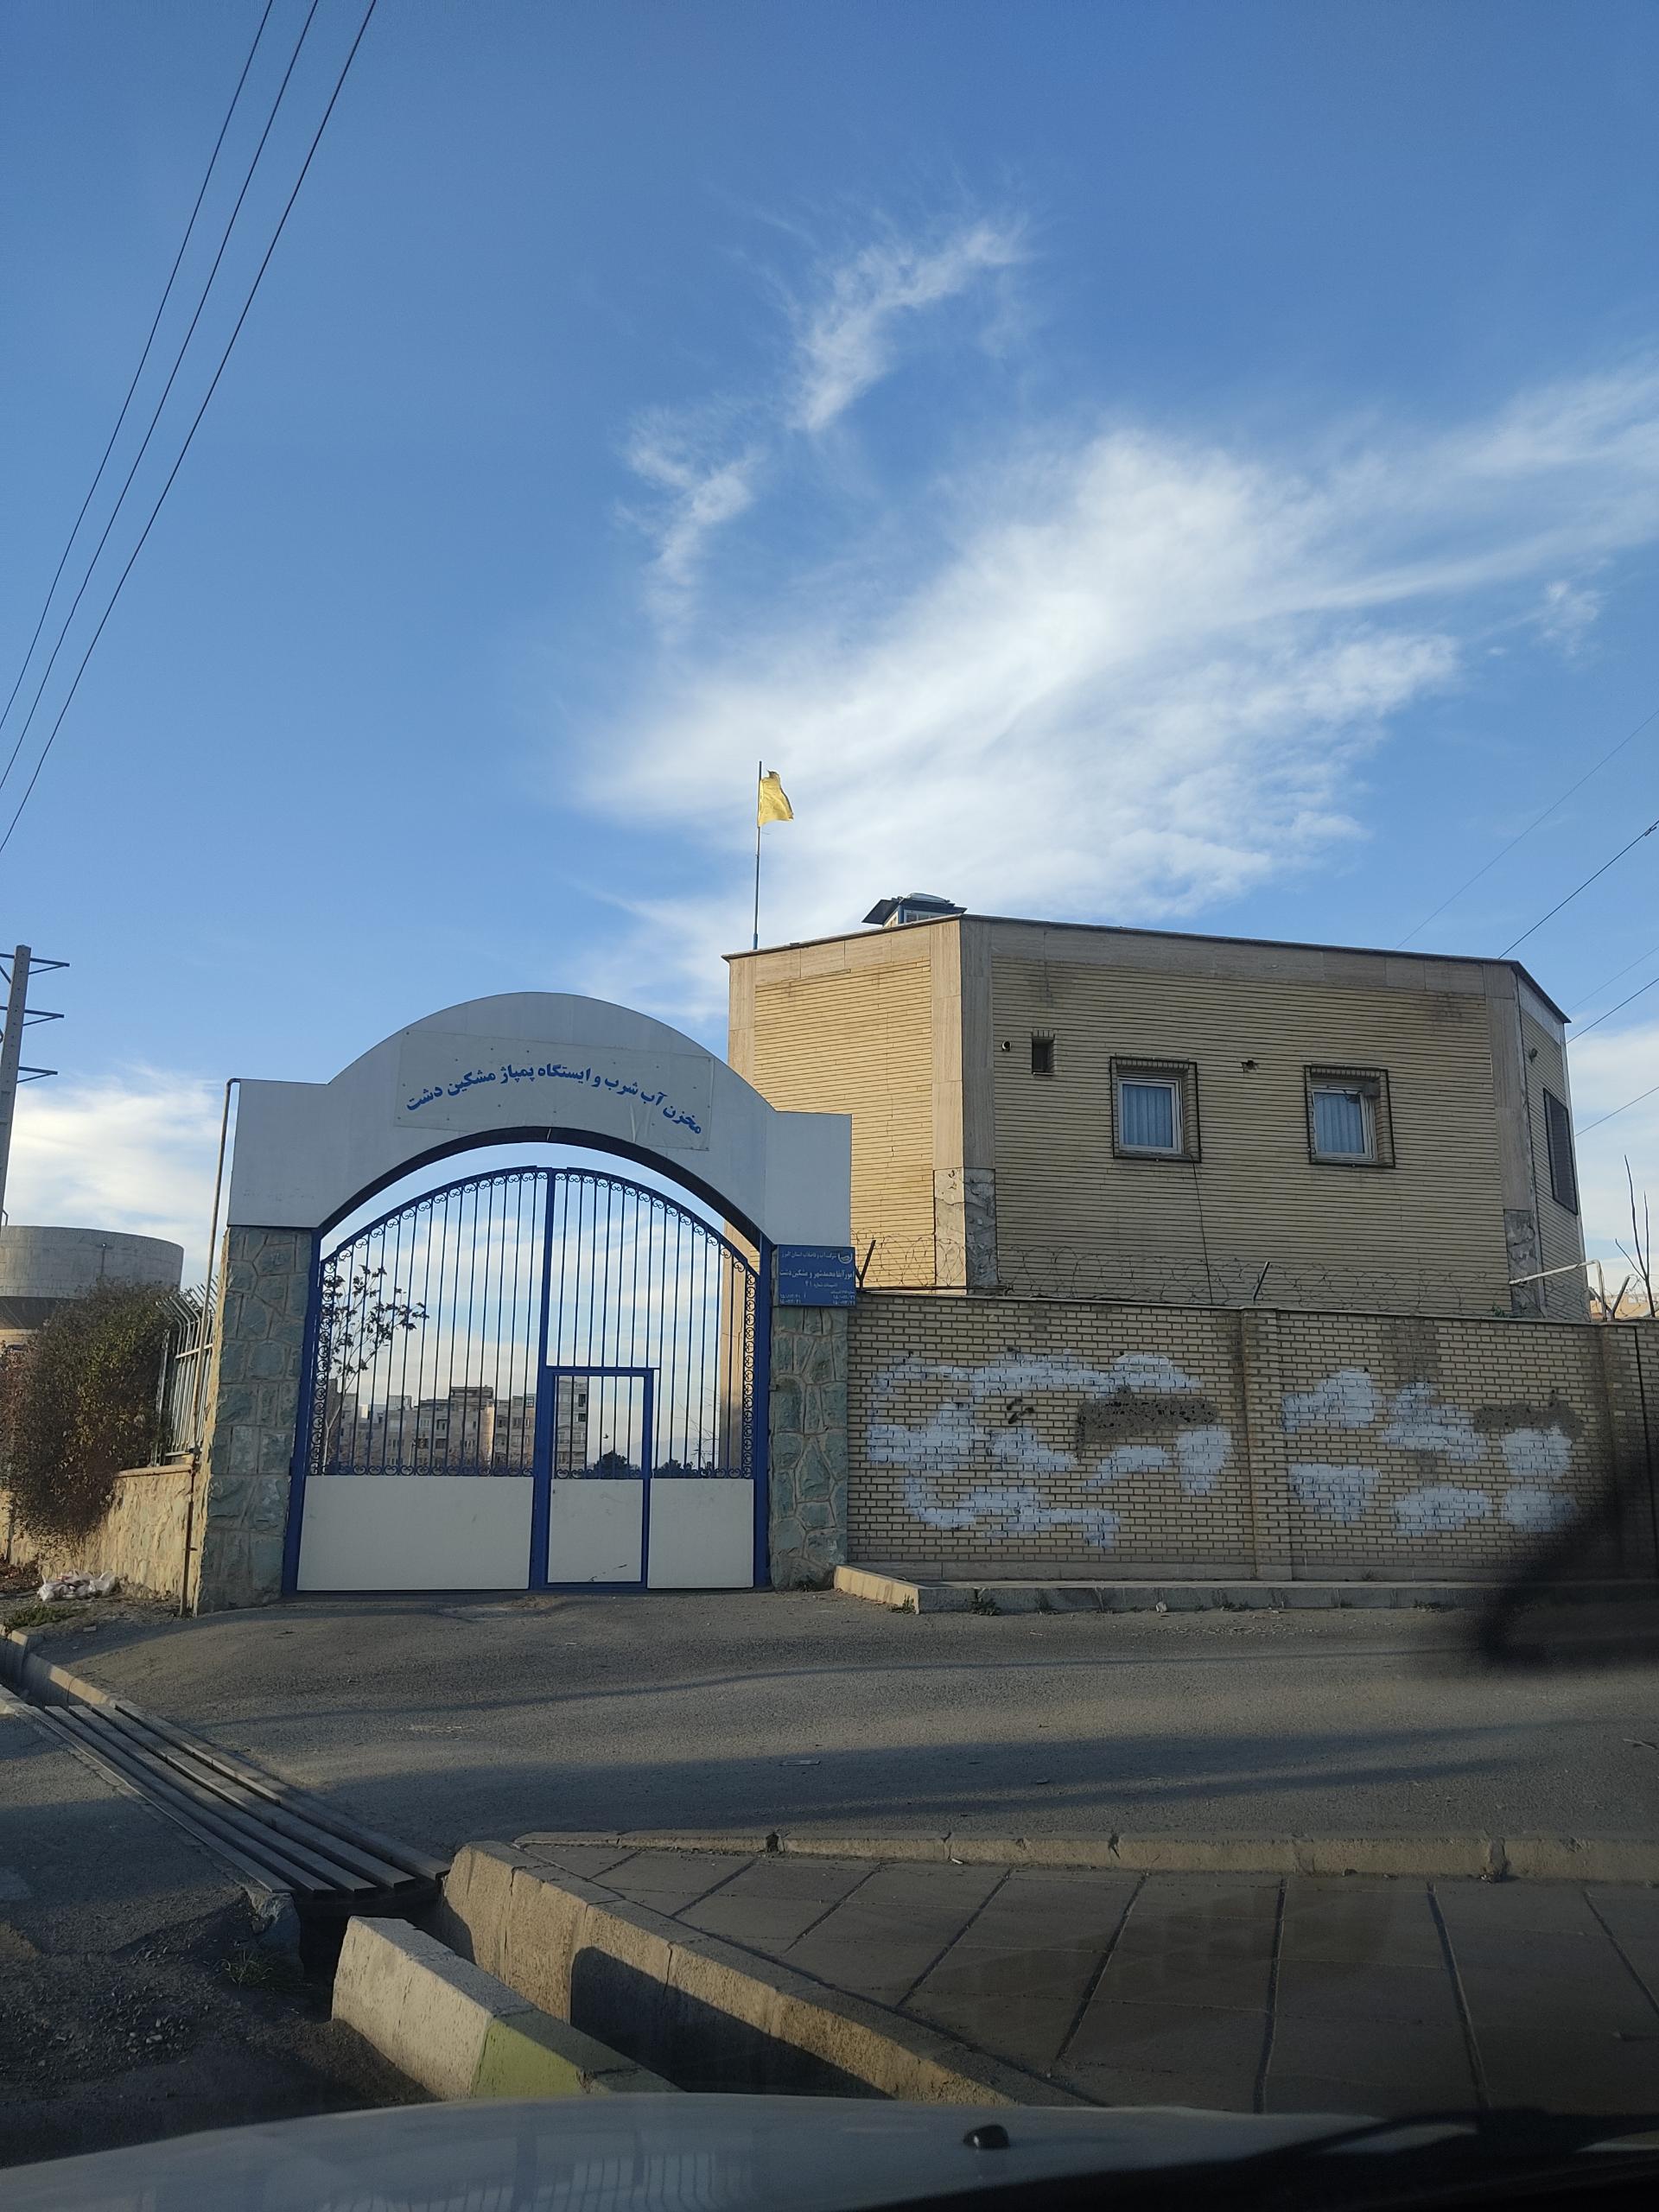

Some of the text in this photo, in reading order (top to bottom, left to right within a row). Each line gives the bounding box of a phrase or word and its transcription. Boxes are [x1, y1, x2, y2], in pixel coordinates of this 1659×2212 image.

[405, 1063, 702, 1135] مخزن آب شرب و ایستگاه پمپاژ مشکین دشت
